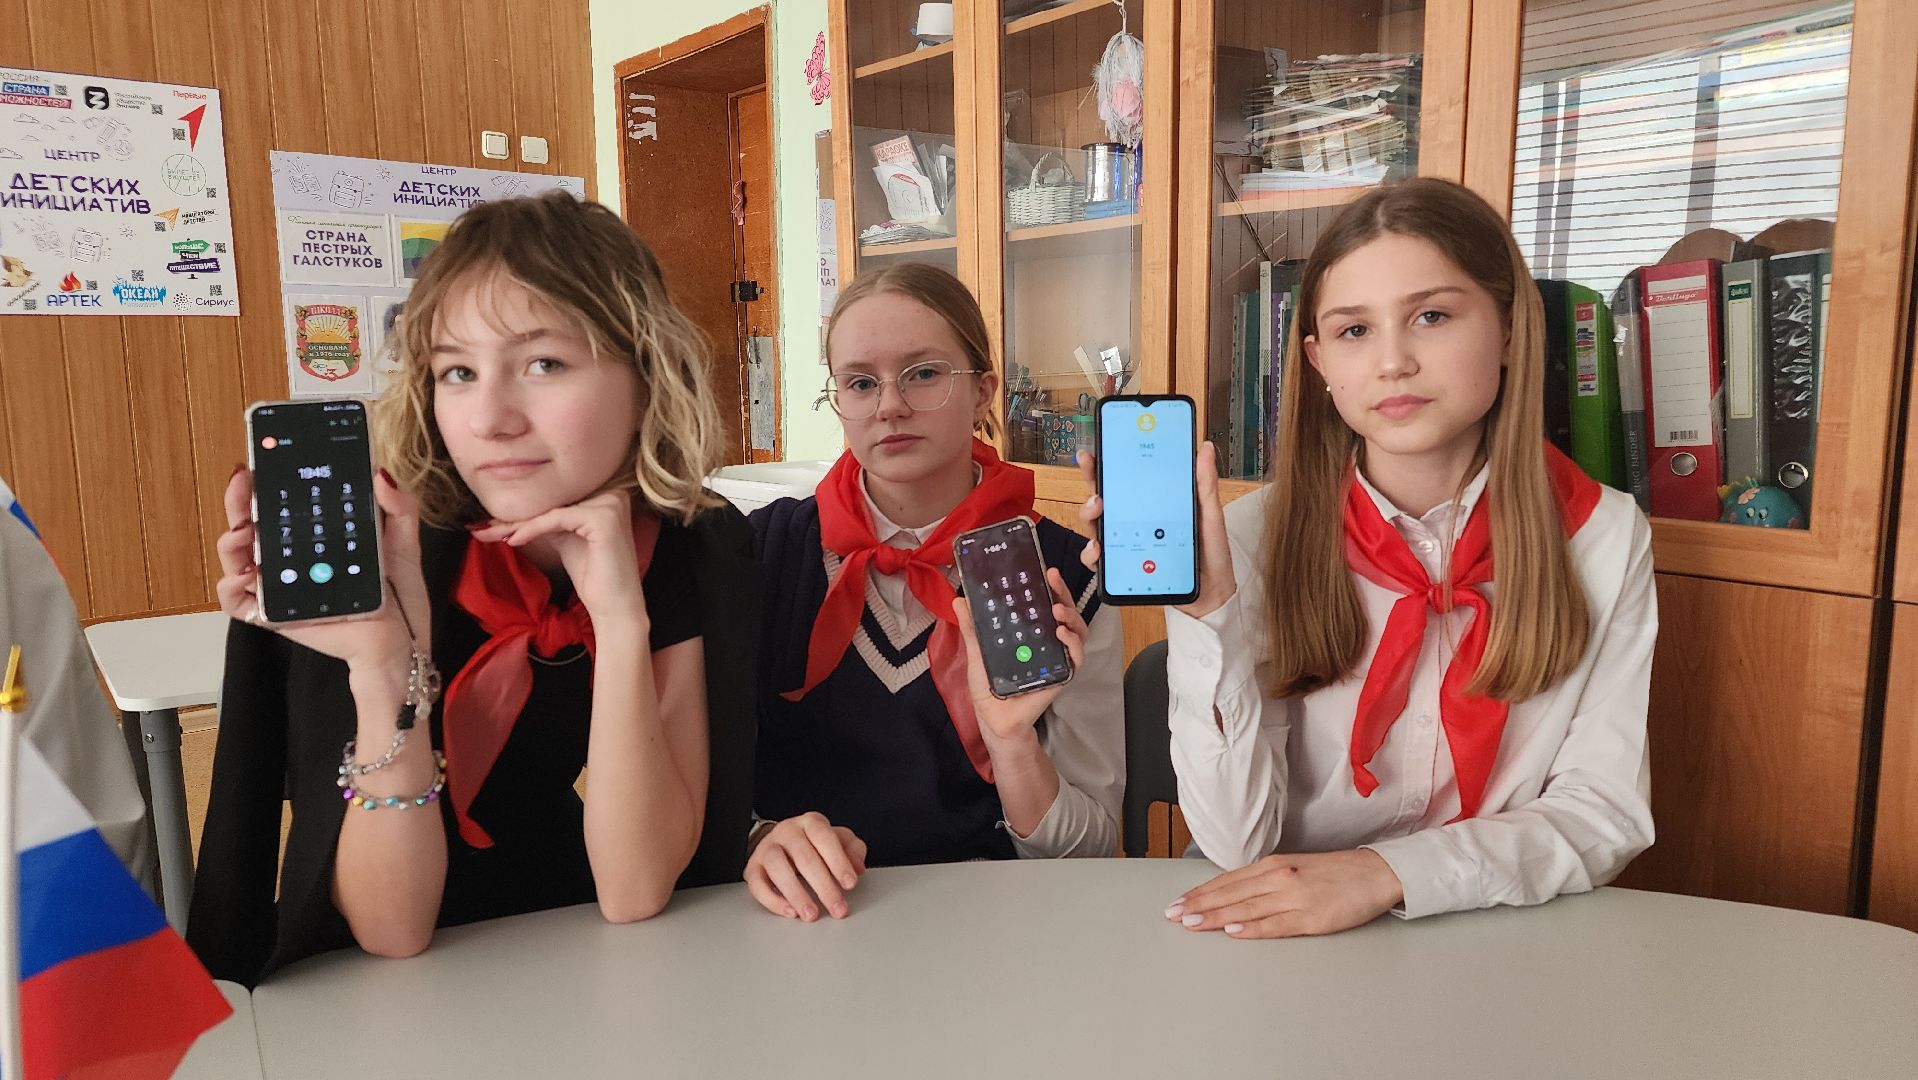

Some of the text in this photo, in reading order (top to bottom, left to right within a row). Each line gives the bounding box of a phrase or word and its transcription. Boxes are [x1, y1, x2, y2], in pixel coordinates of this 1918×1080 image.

[4, 83, 48, 95] СТРАНА
[44, 149, 99, 162] ЦЕНТР
[421, 165, 457, 176] ЦЕНТР
[10, 172, 141, 195] ДЕТСКИХ
[398, 181, 481, 198] ДЕТСКИХ
[0, 193, 152, 215] ИНИЦИАТИВ
[305, 229, 367, 243] СТРАНА
[302, 243, 373, 256] ПЕСТРЫХ
[292, 254, 383, 269] ГАЛСТУКОВ
[121, 288, 159, 299] ОКЕАН
[47, 294, 102, 307] АРТЕК
[195, 297, 235, 307] Сириус
[1630, 430, 1640, 467] BINDER
